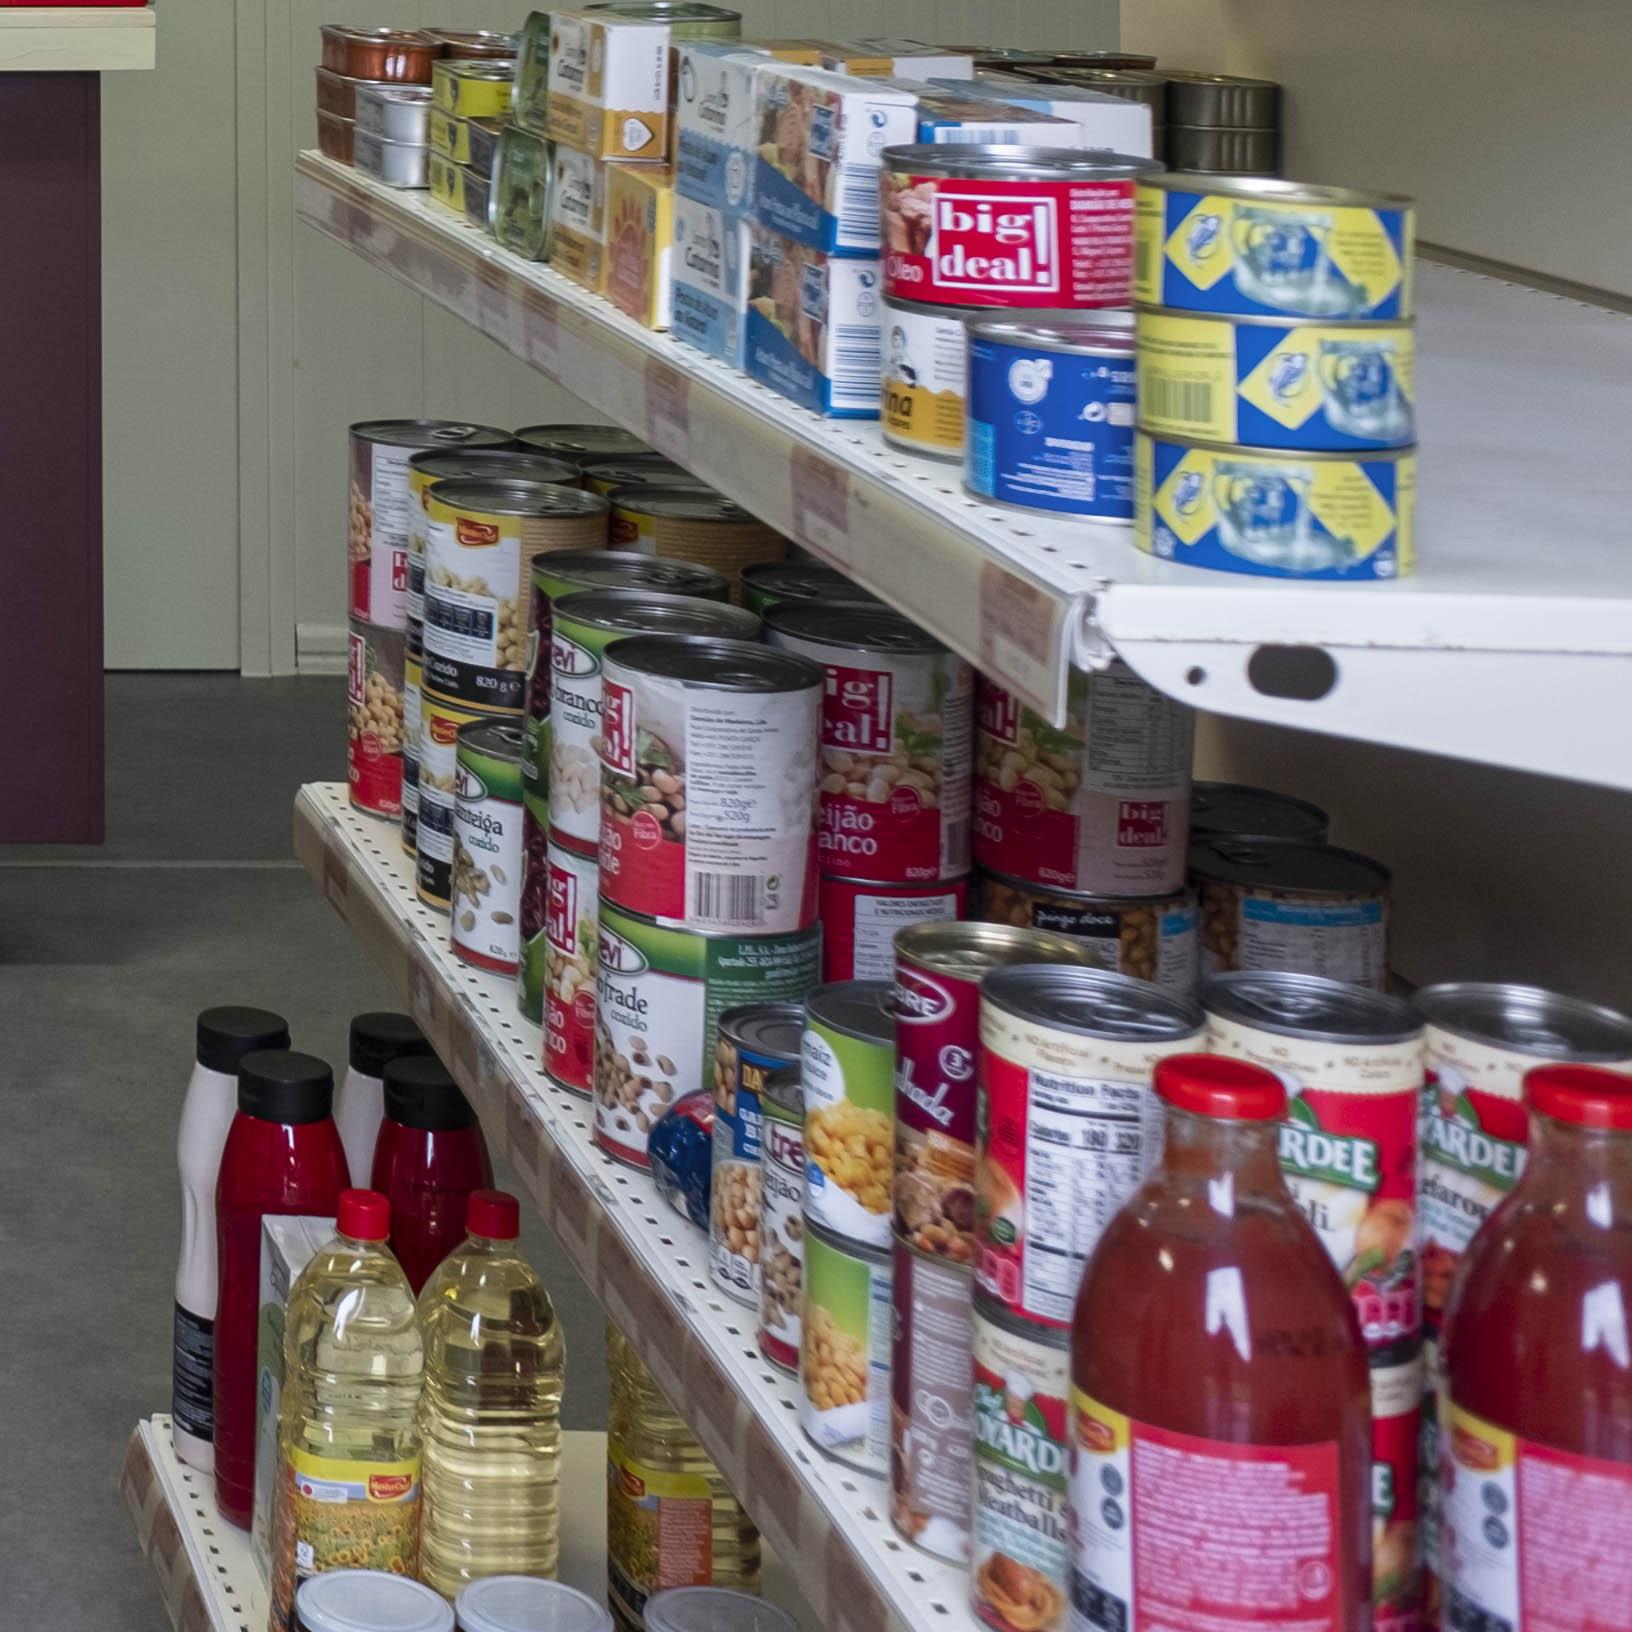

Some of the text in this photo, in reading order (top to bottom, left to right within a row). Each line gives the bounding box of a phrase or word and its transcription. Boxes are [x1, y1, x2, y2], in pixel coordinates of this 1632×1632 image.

[940, 201, 1033, 244] big
[940, 244, 1052, 284] deal!
[552, 644, 577, 673] evi
[475, 675, 498, 691] 820
[825, 667, 876, 710] ig
[822, 800, 874, 835] ijão
[599, 935, 624, 969] evi
[1033, 1073, 1094, 1097] Nutrition
[770, 1127, 803, 1167] tre
[1279, 1125, 1375, 1186] RDEE
[764, 1172, 801, 1204] eijão
